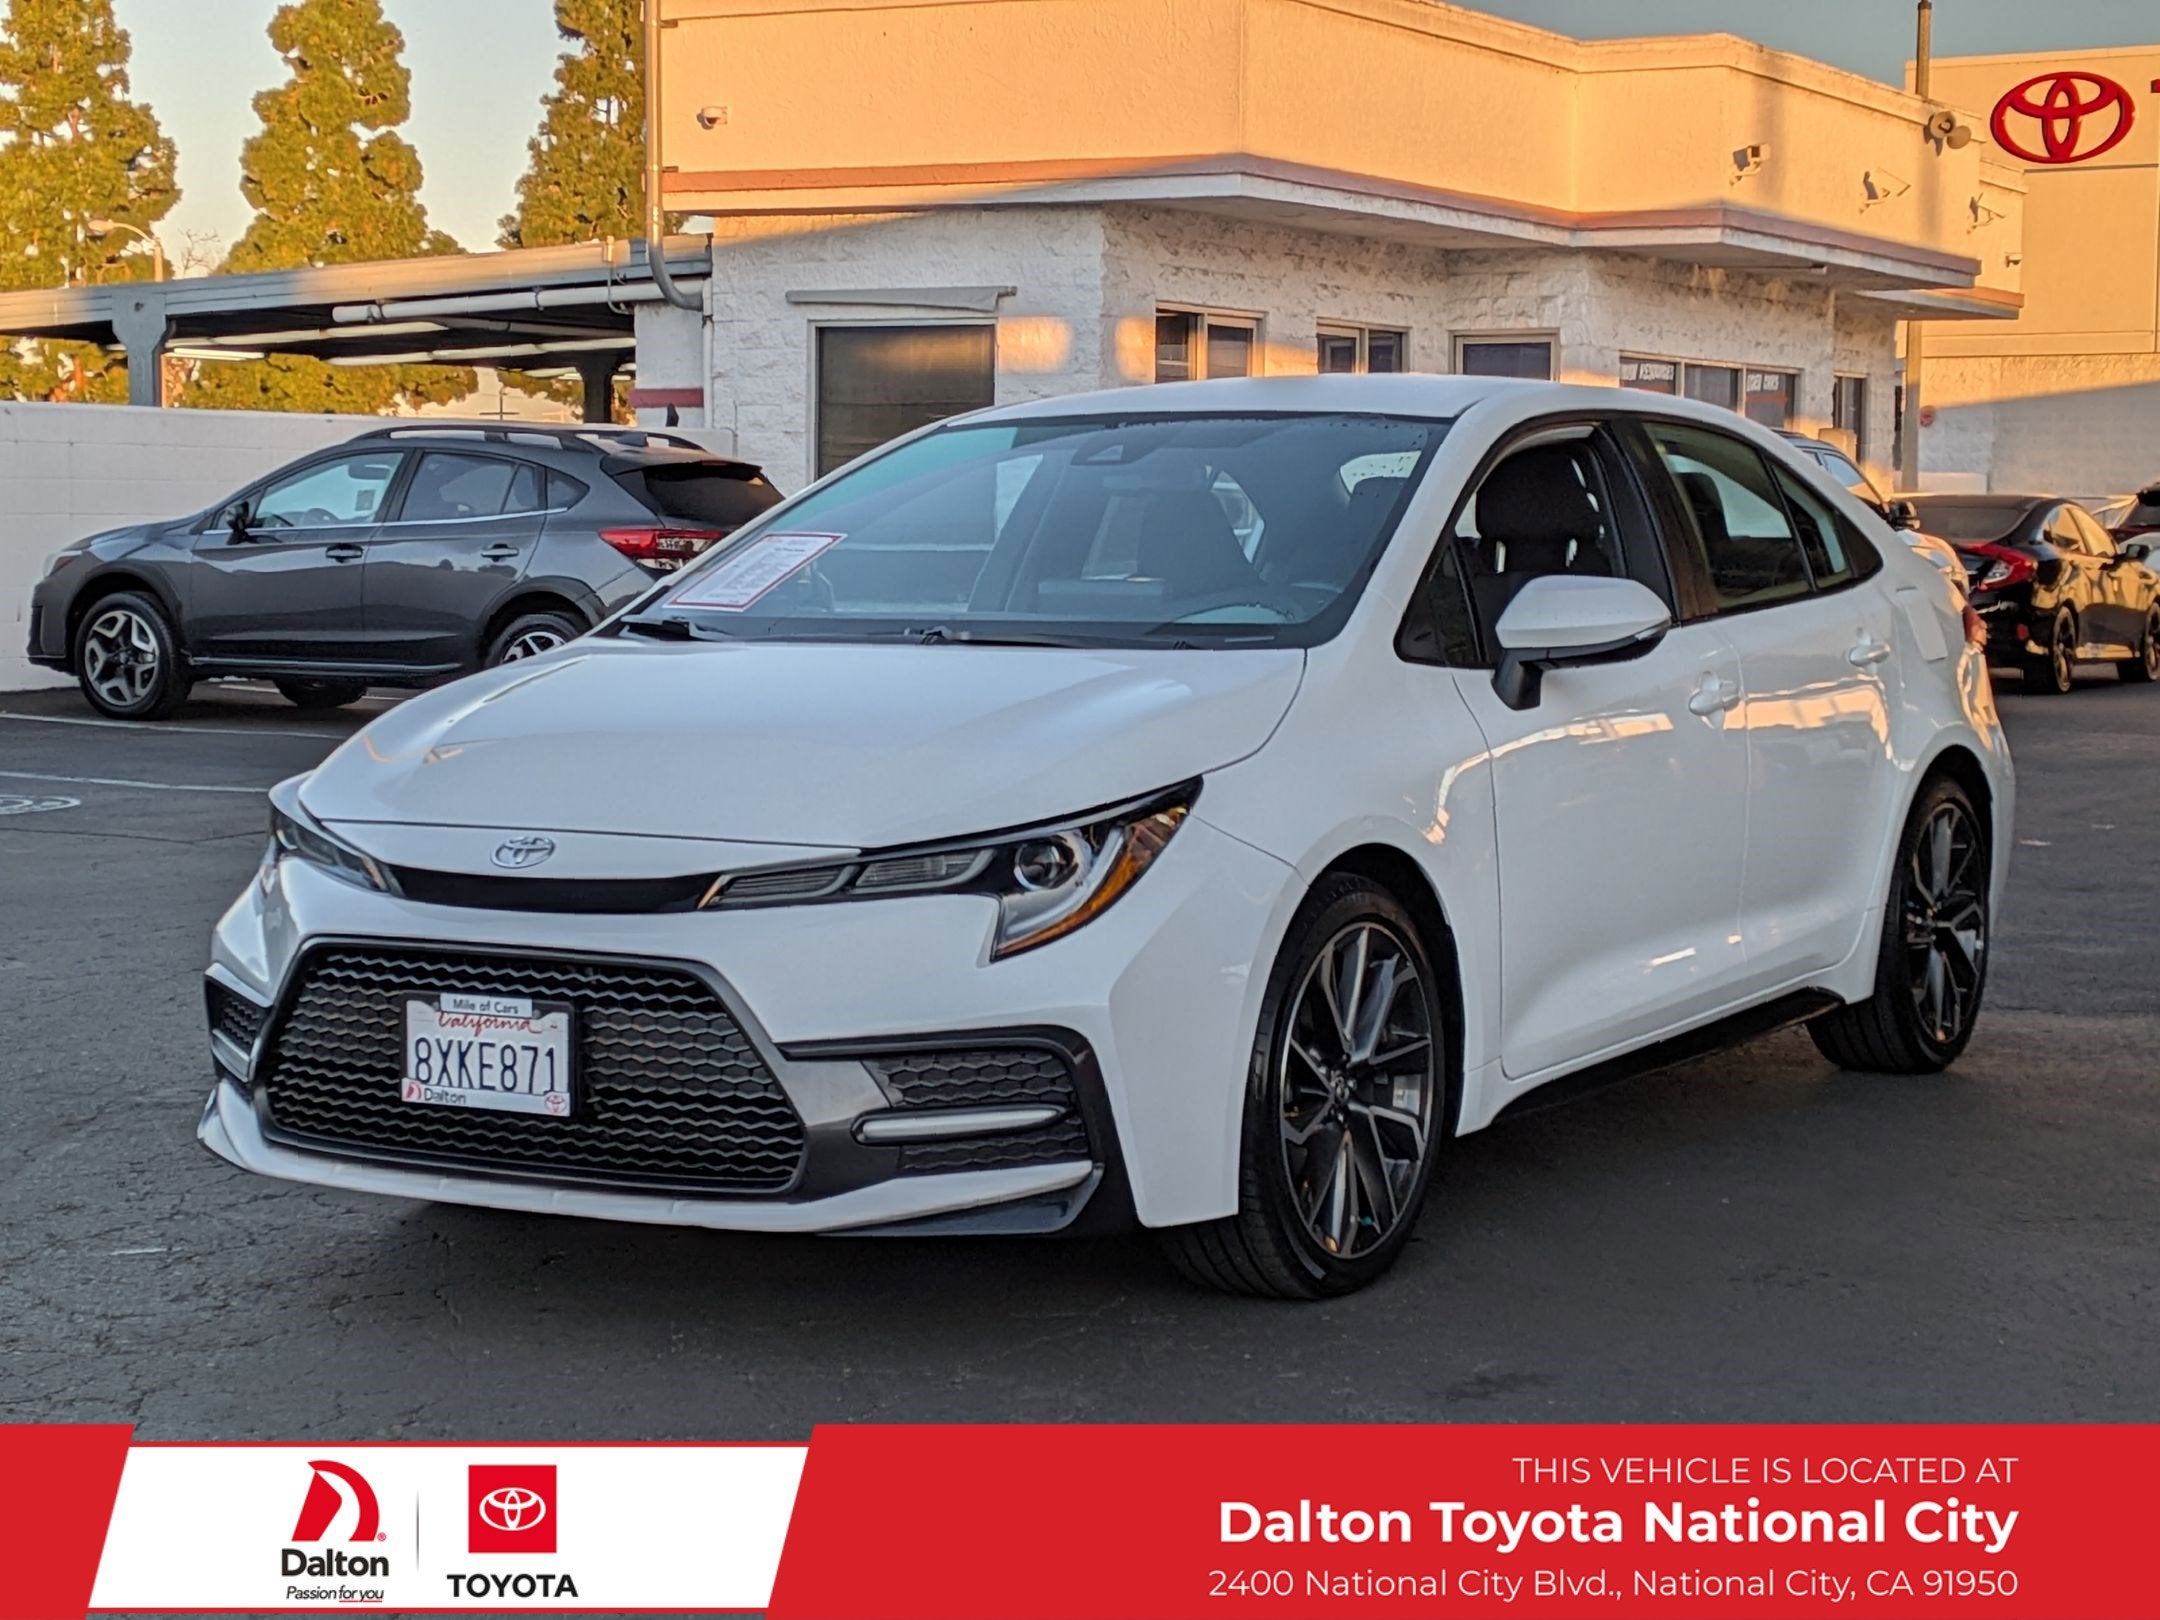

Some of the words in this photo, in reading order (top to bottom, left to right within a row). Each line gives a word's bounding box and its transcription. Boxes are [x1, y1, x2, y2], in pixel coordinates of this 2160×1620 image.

[453, 999, 475, 1011] Mile
[480, 1001, 490, 1012] of
[495, 1002, 519, 1014] Cars
[438, 1012, 542, 1036] California
[415, 1037, 555, 1096] 8XKE871
[424, 1088, 466, 1104] Dalton
